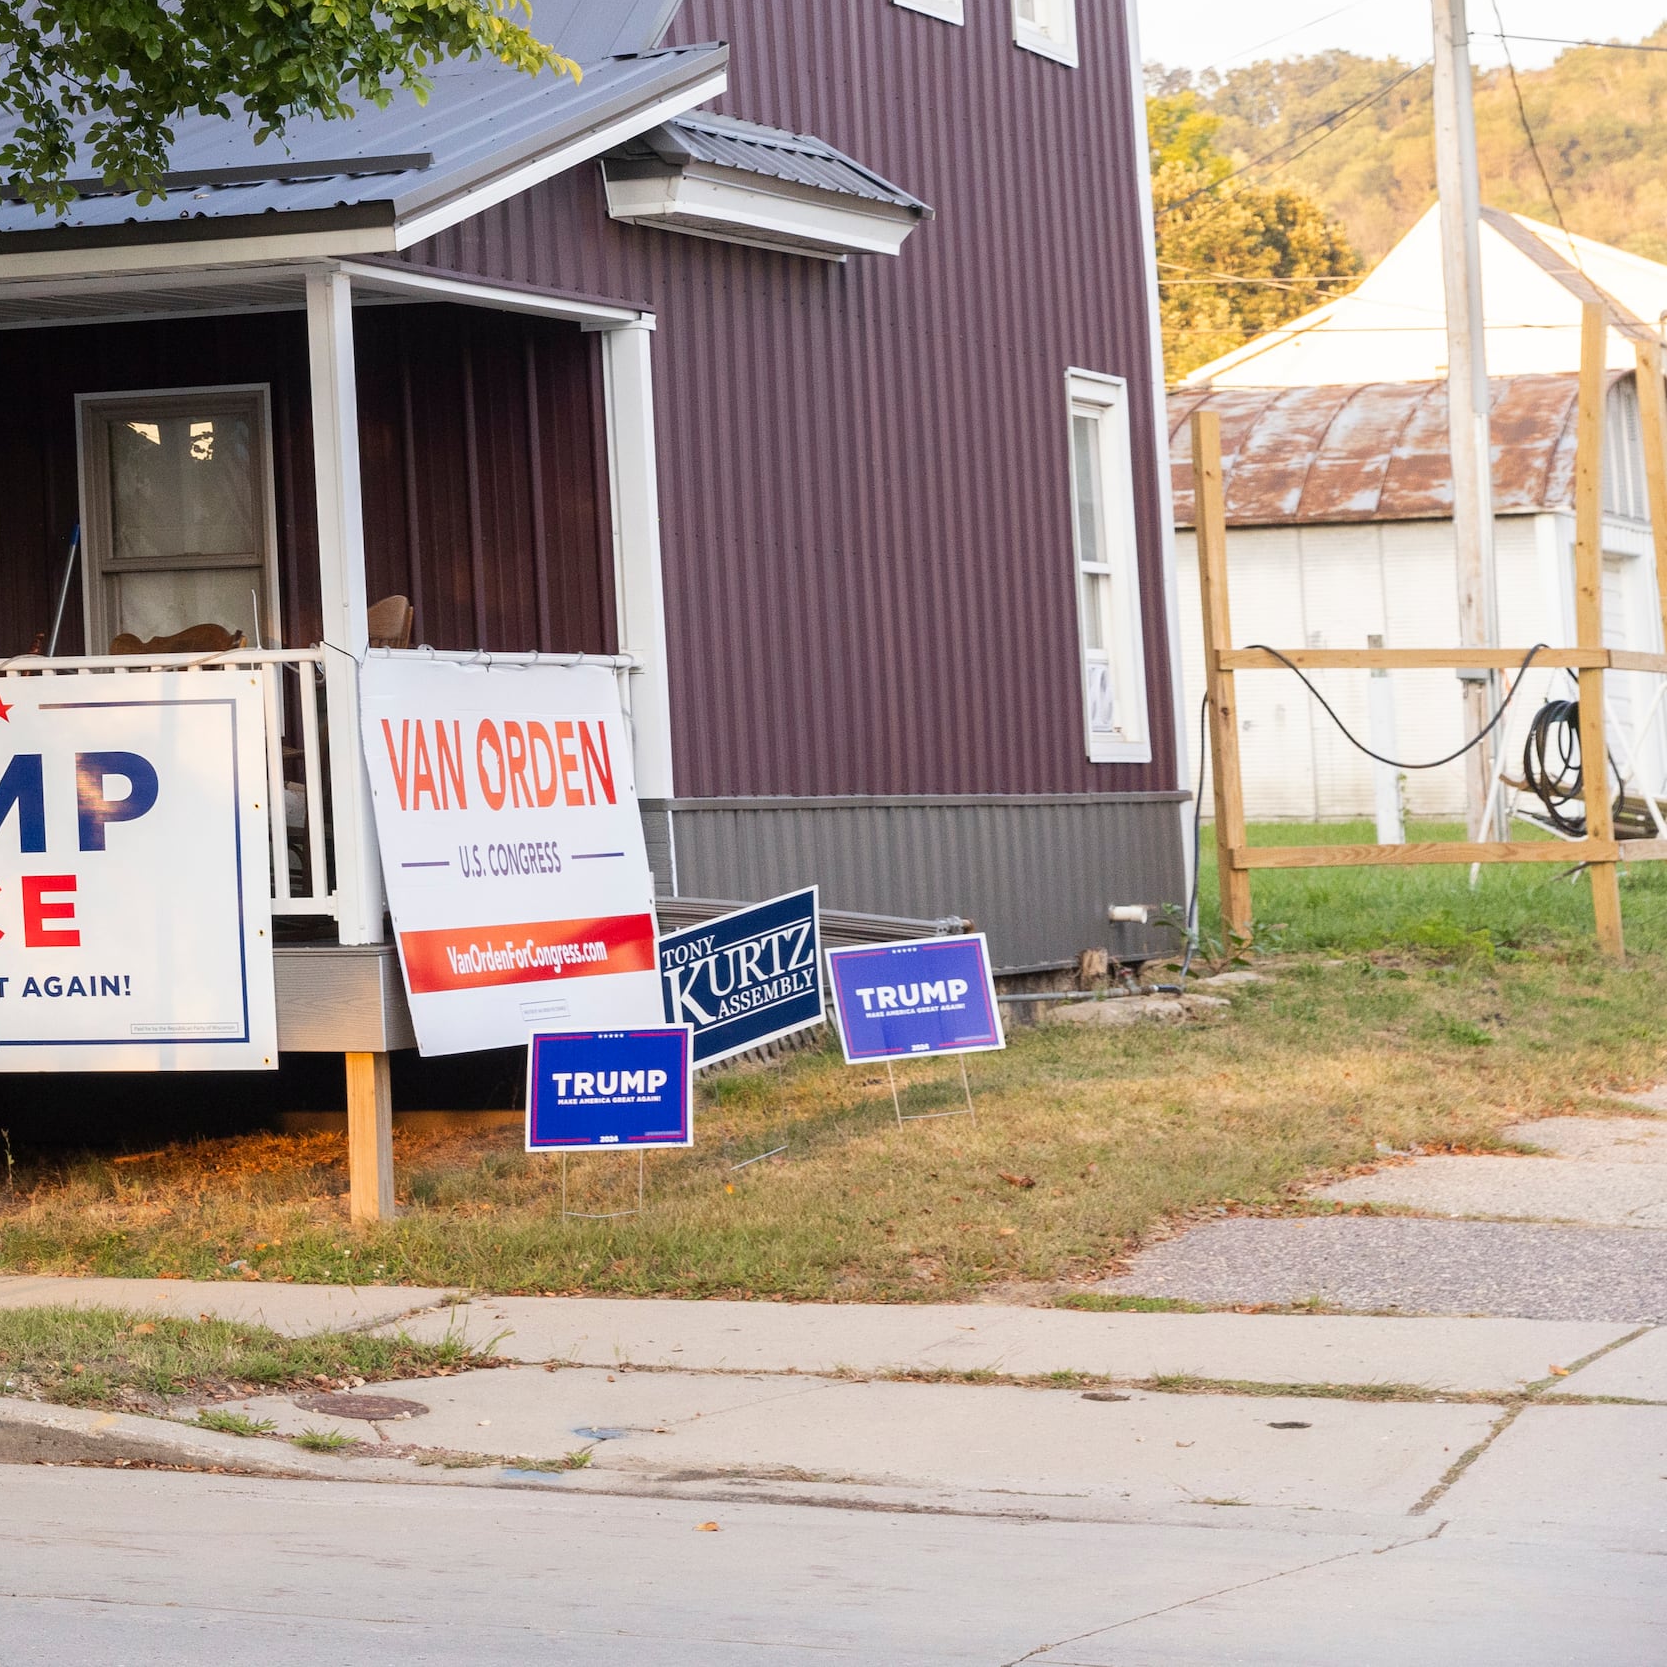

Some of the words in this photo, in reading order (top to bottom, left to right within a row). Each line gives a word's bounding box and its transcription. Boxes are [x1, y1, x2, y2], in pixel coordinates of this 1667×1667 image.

[381, 719, 468, 811] VAN
[476, 718, 617, 811] ORDEN
[459, 844, 487, 878] U.S.
[488, 841, 562, 877] CONGRESS
[446, 939, 609, 975] VanOrdenForCongress.com
[662, 935, 716, 969] TONY
[21, 974, 132, 999] AGAIN!
[663, 921, 815, 1025] KURTZ
[717, 967, 815, 1020] ASSEMBLY
[855, 978, 969, 1011] TRUMP
[552, 1069, 668, 1096] TRUMP
[579, 1097, 611, 1105] AMERICA
[612, 1096, 635, 1104] GREAT
